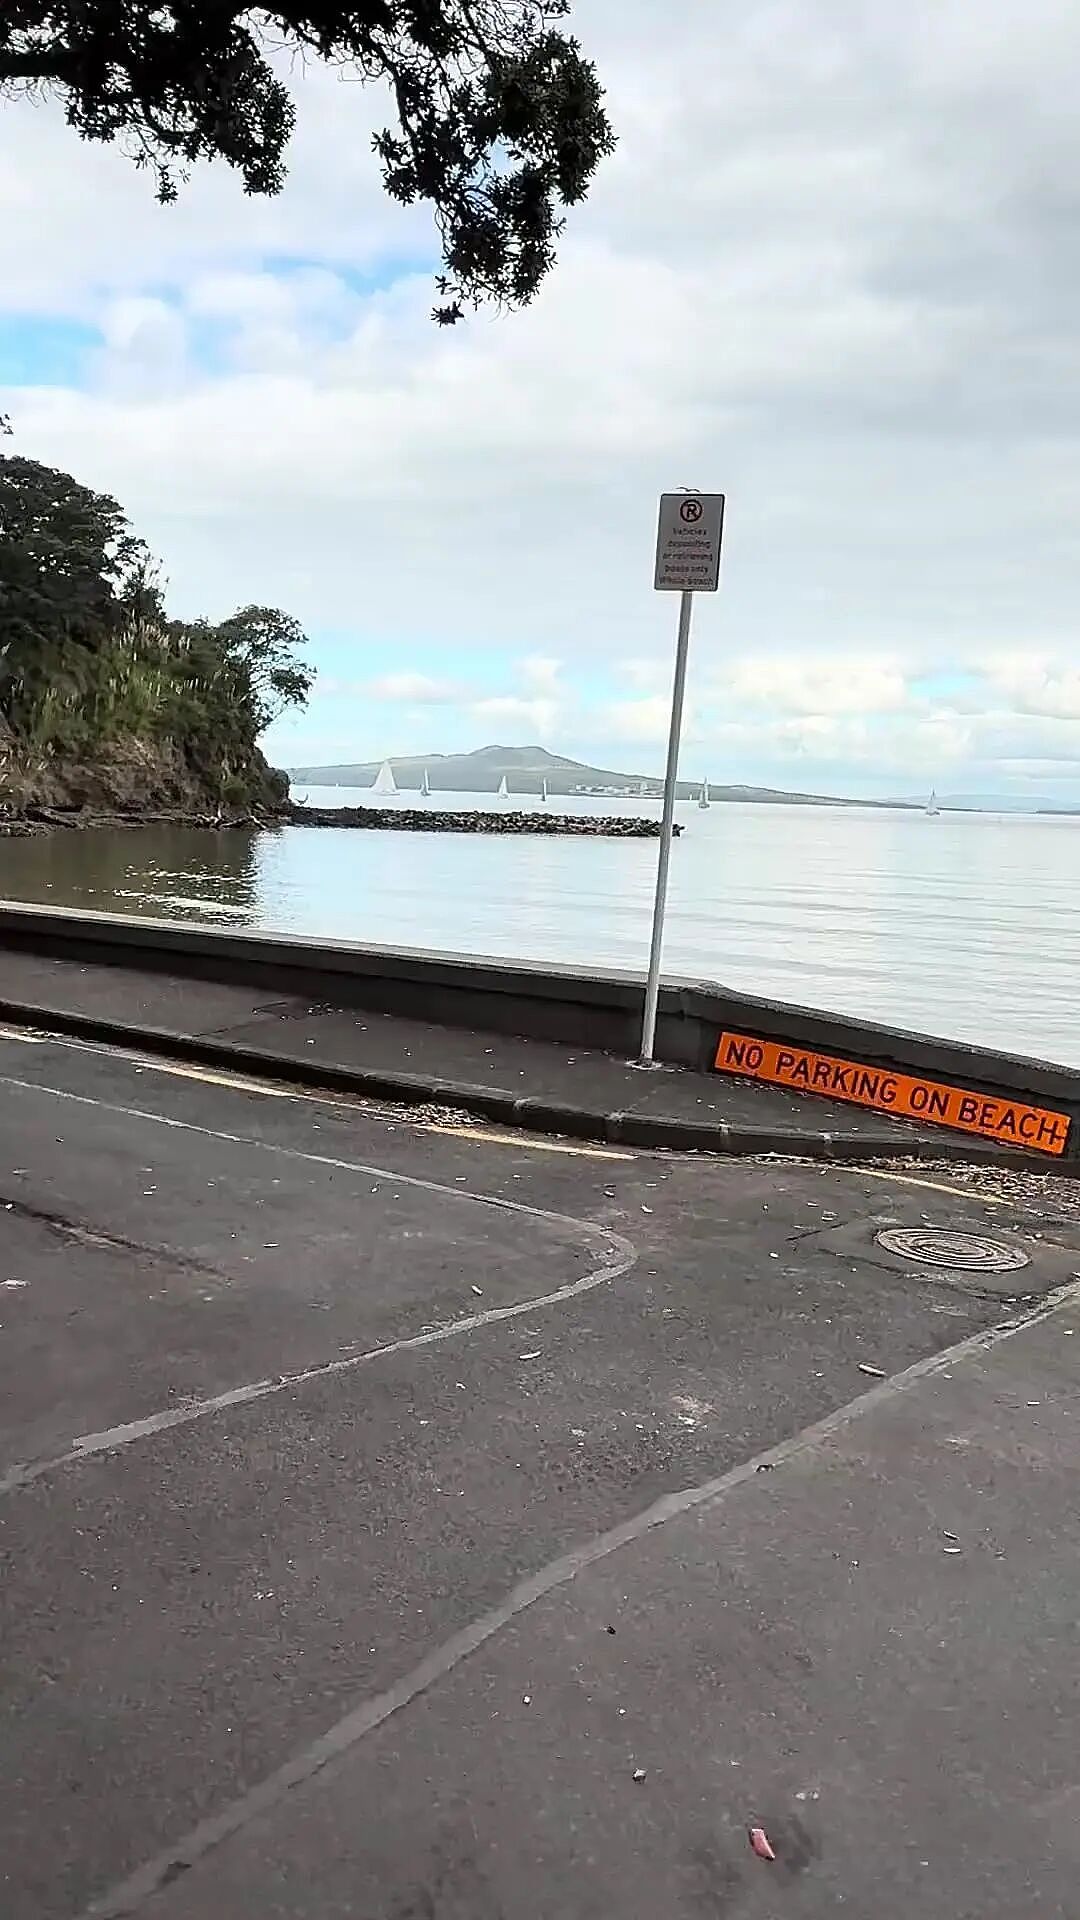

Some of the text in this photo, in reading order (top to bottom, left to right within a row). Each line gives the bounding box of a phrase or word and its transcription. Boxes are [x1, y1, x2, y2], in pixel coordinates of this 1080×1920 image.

[726, 1040, 1061, 1145] NO PARKING ON BEACH
